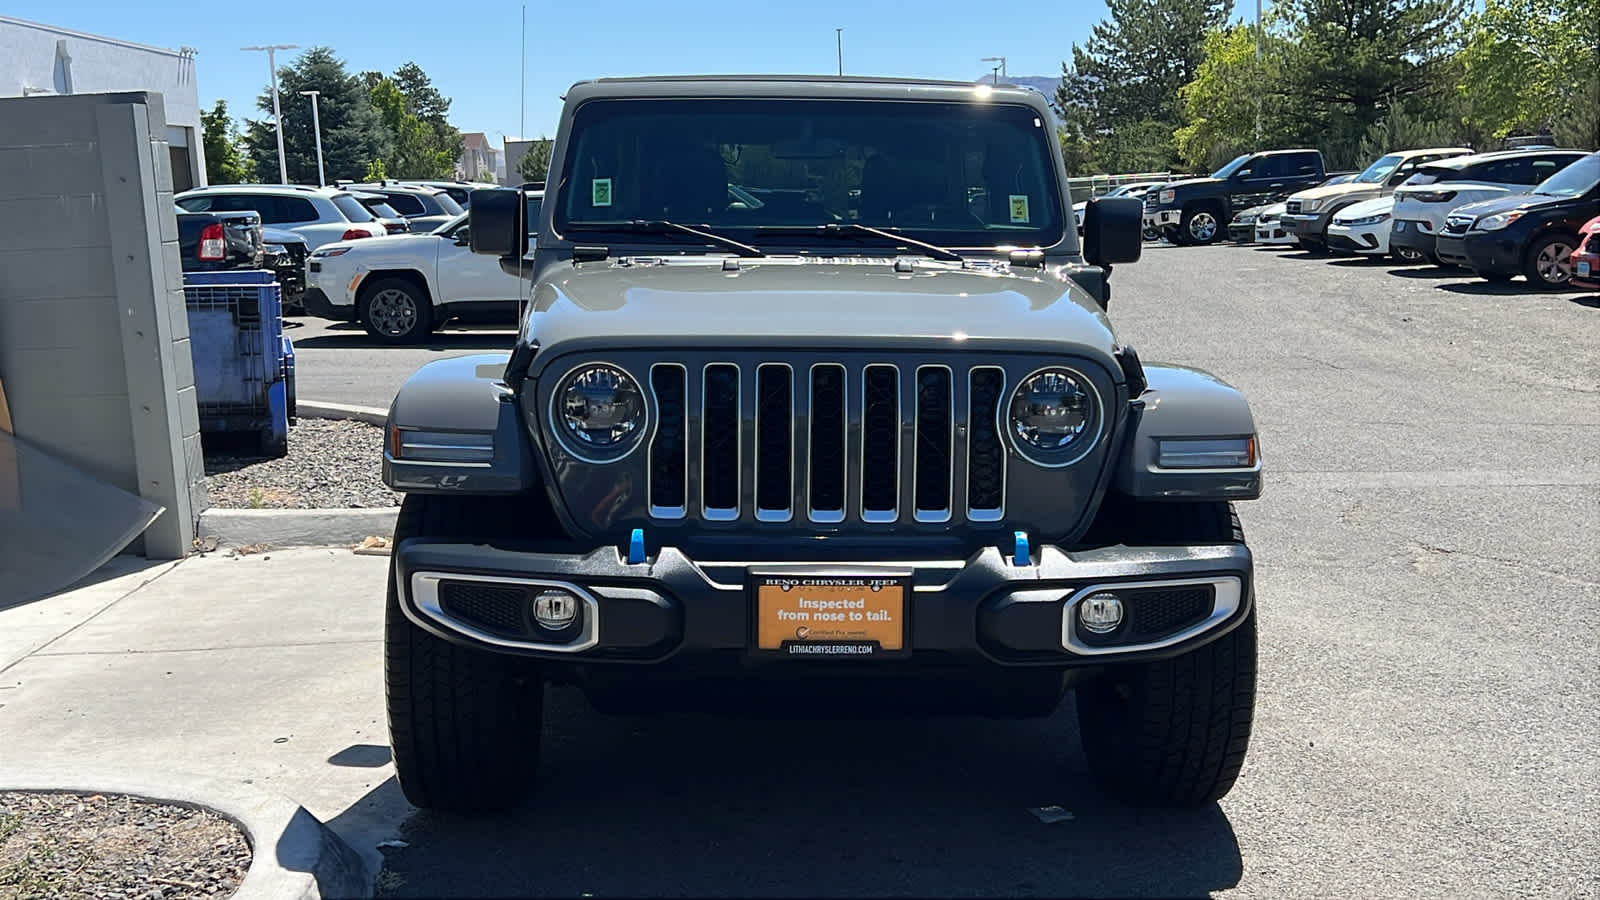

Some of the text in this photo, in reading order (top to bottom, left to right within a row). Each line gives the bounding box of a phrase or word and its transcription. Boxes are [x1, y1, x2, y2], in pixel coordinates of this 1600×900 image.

[799, 597, 865, 611] Inspected
[777, 609, 892, 621] from nose to tail.
[789, 645, 873, 654] LITHIACHRYSLERRENO.COM
